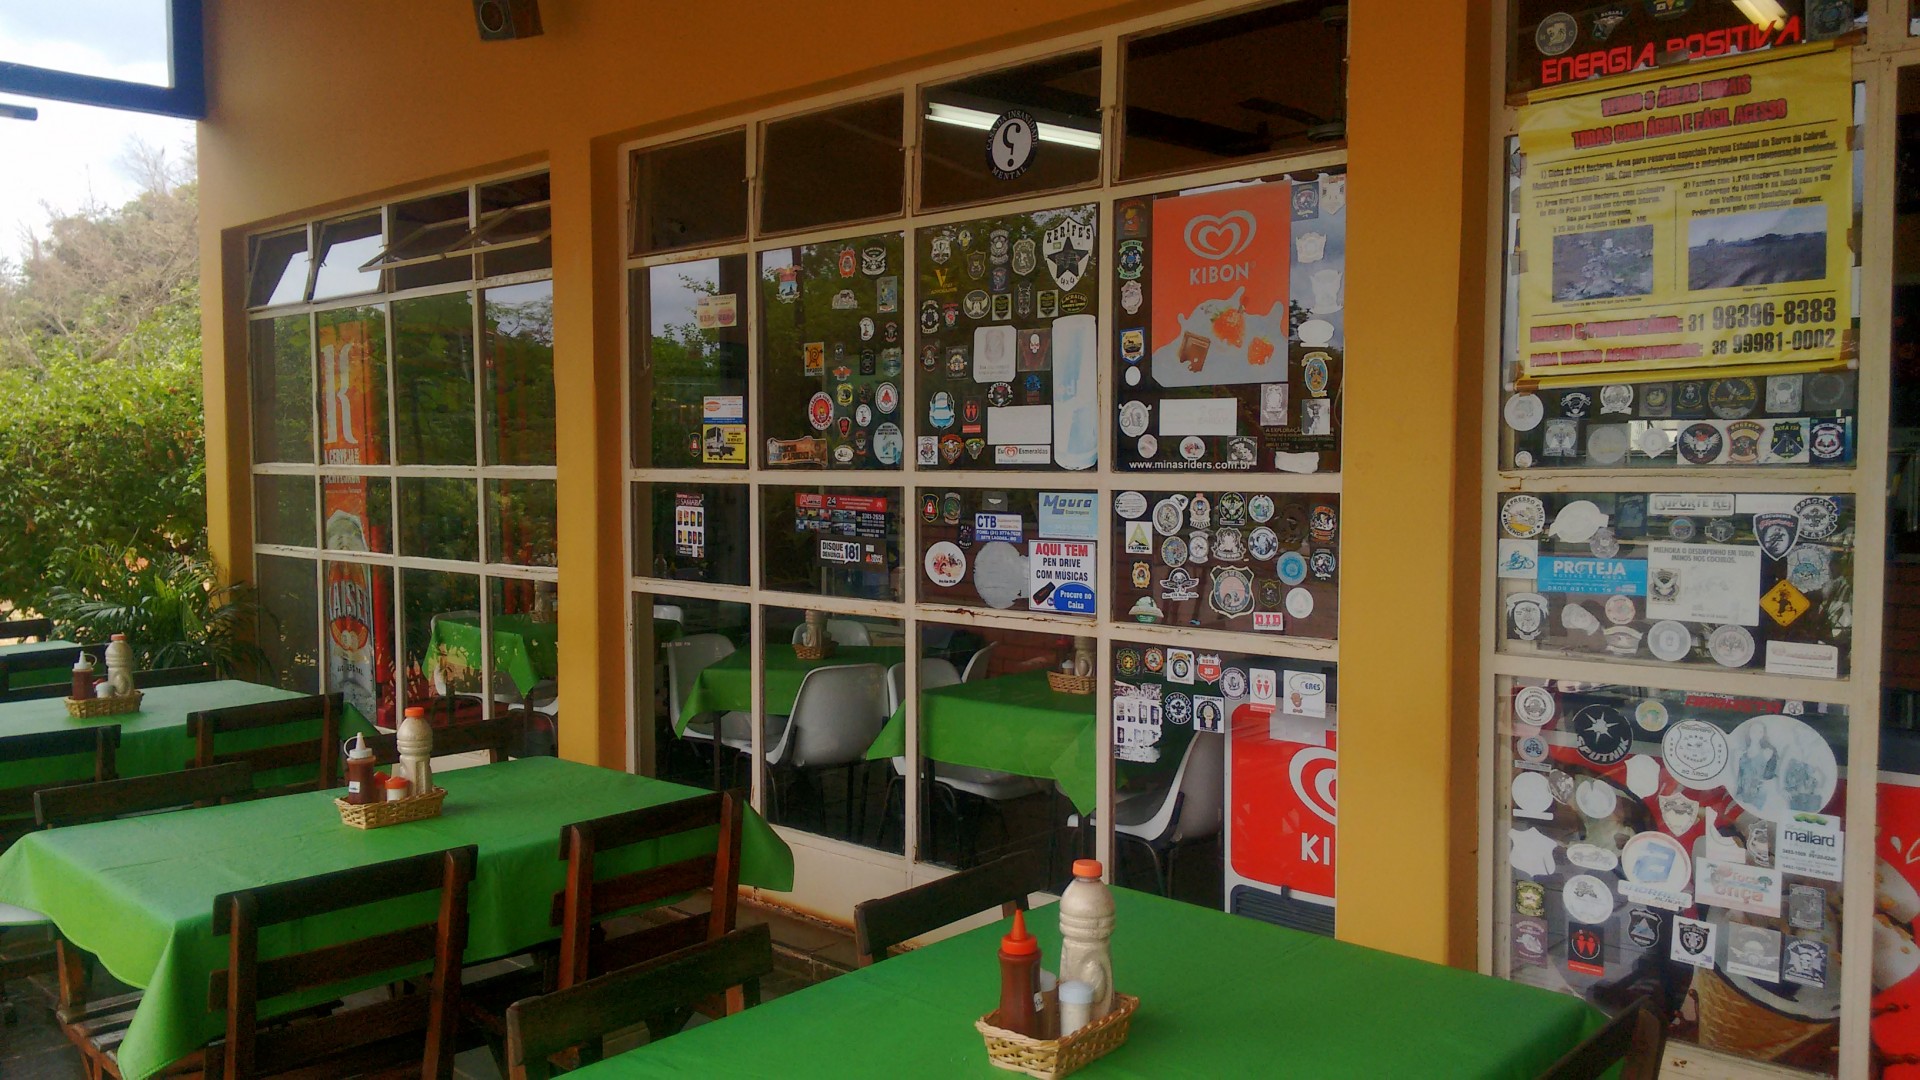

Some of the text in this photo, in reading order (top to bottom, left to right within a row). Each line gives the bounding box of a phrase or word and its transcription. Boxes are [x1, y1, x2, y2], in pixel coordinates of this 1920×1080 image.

[1542, 15, 1799, 84] ENERGIA POSITIVA
[1644, 90, 1655, 111] 3
[1656, 83, 1700, 108] ÁREAS
[1571, 98, 1788, 150] TODAS COM ÁGUA E FÁCIL ACESSO
[986, 127, 998, 150] CASA
[992, 166, 1028, 181] MENTAL
[1046, 221, 1091, 244] XERIFE'S
[1189, 261, 1249, 286] KIBON
[1688, 297, 1836, 332] 31 98396-8383
[1712, 340, 1727, 355] 38
[1732, 328, 1836, 354] 99981-0002
[1129, 459, 1251, 470] www.minasriders.com.br
[977, 515, 997, 528] CTB
[822, 542, 843, 551] DISQUE
[844, 543, 859, 560] 181
[1036, 543, 1088, 557] AQUI TEM
[1688, 548, 1727, 556] DESEMPENHO
[1043, 557, 1081, 568] PEN DRIVE
[1553, 560, 1627, 575] PROTEJA
[1036, 569, 1088, 581] COM MÚSICAS
[1060, 590, 1083, 599] Procure
[1067, 601, 1084, 609] Caixa
[1576, 735, 1631, 763] SPUTNIK
[1784, 830, 1835, 847] mallard
